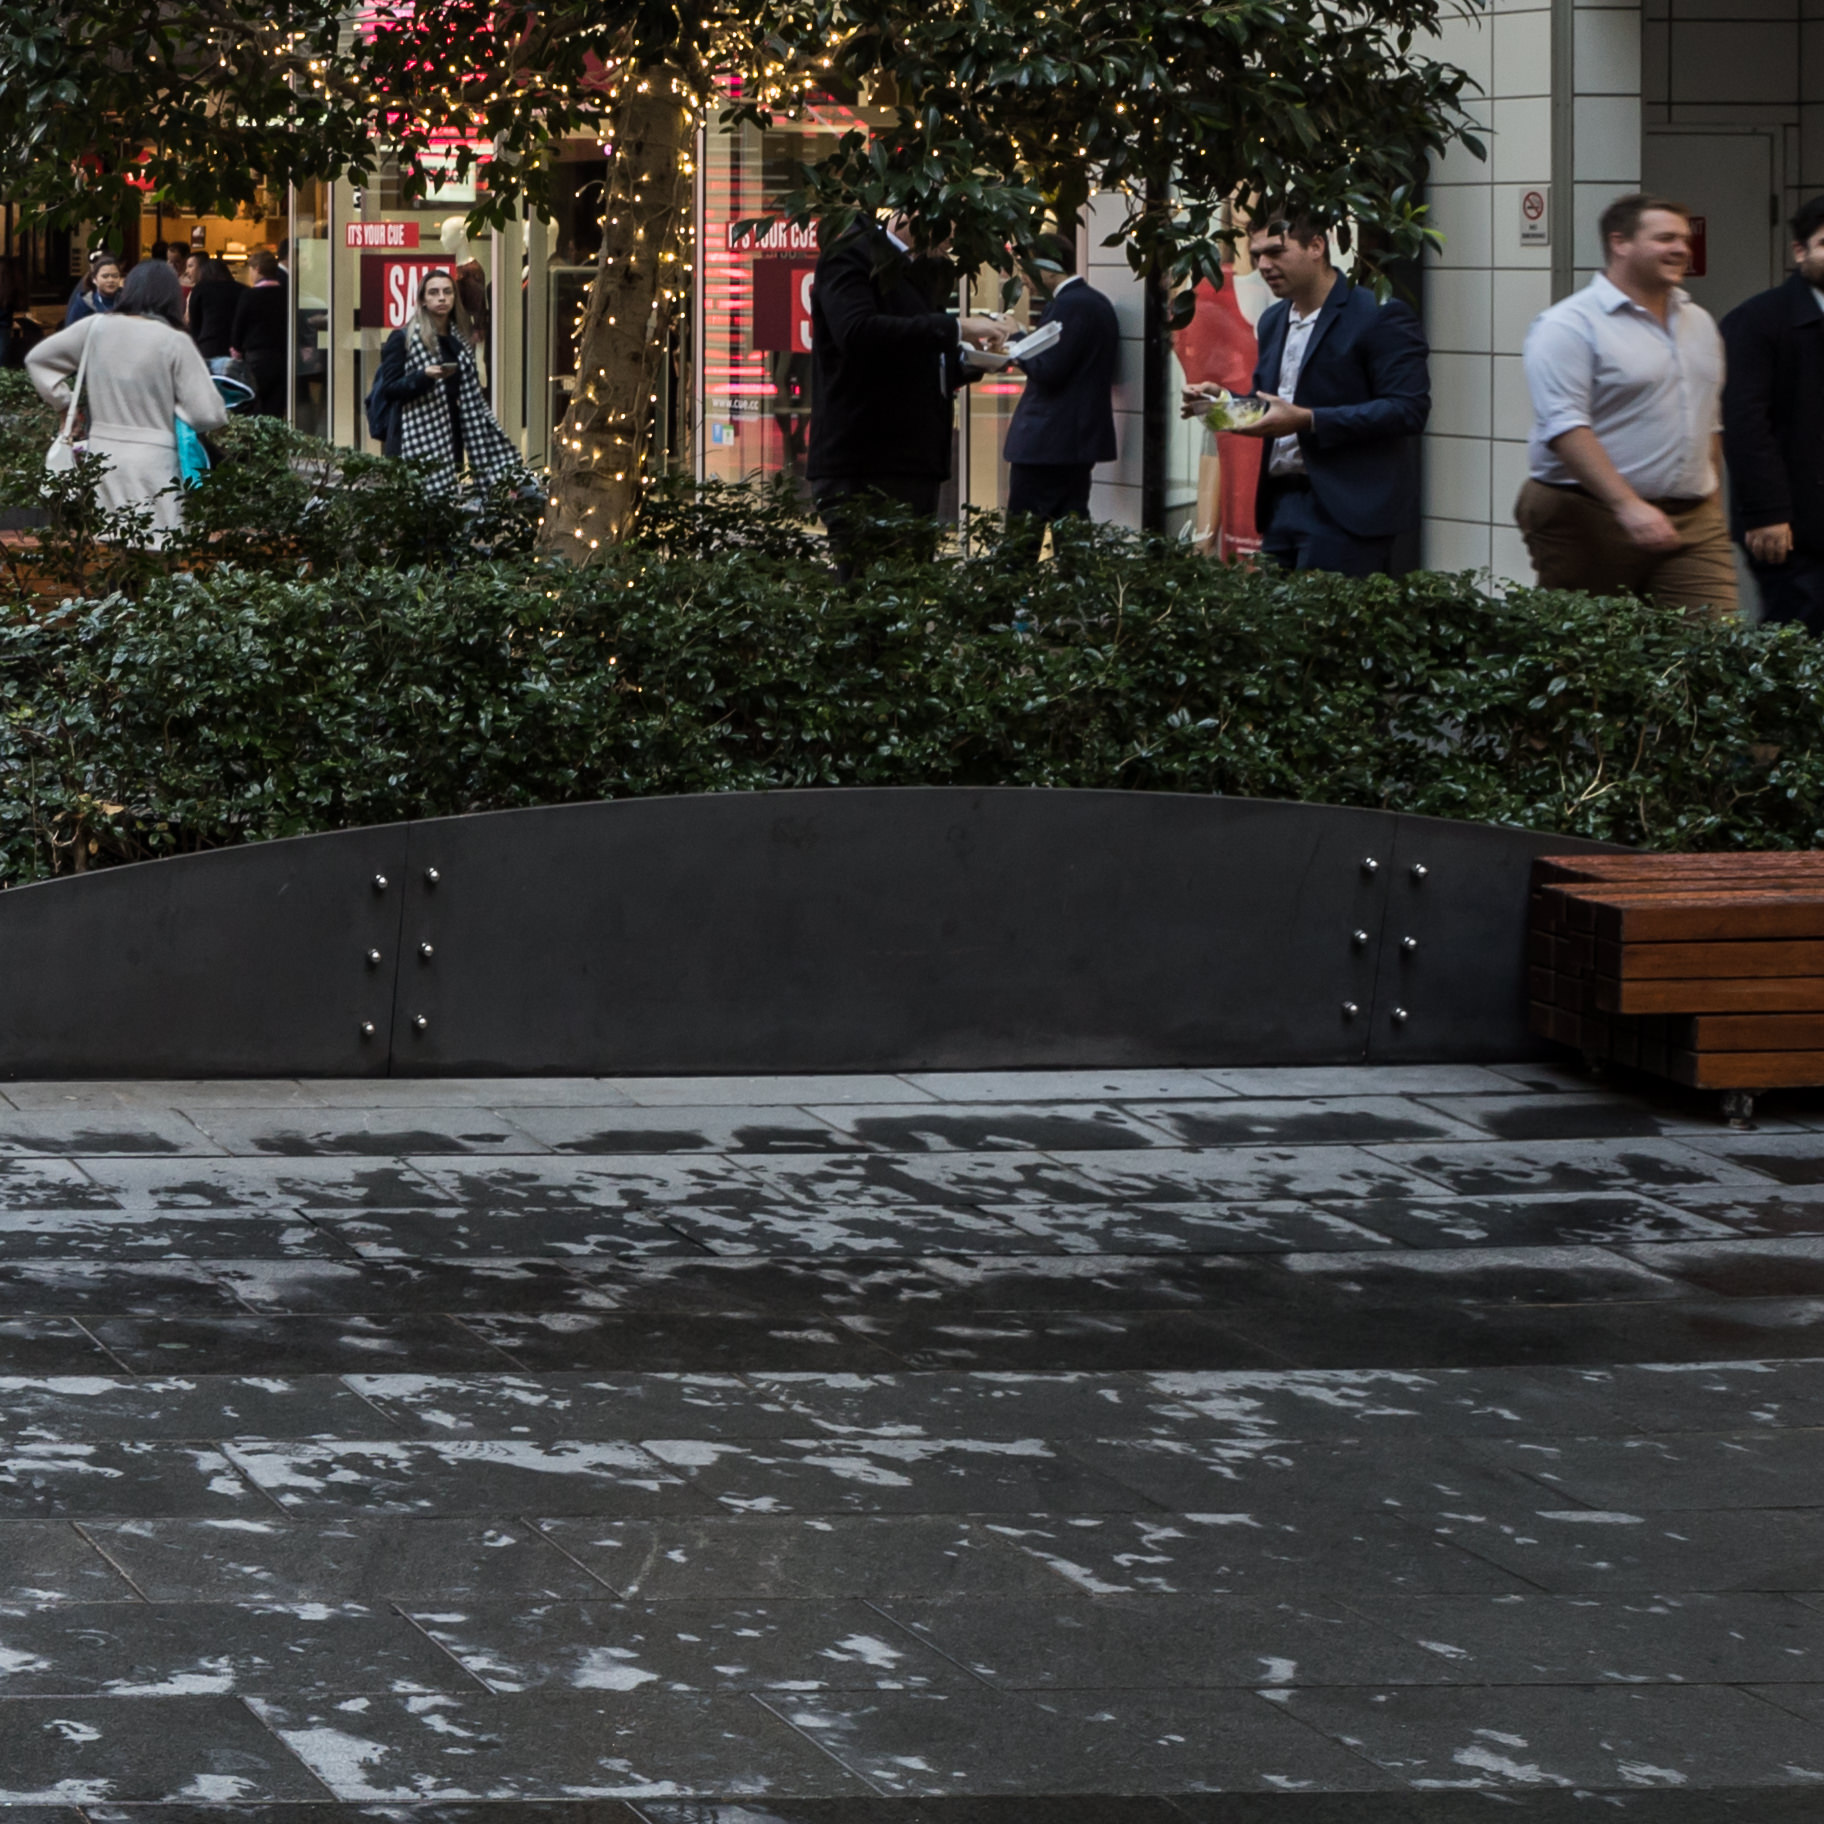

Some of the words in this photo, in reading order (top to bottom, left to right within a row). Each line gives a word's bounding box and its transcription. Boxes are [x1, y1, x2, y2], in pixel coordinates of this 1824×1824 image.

[348, 224, 362, 245] IT'S
[364, 224, 385, 245] YOUR
[387, 224, 405, 245] CUE
[712, 397, 760, 411] www.cue.cc
